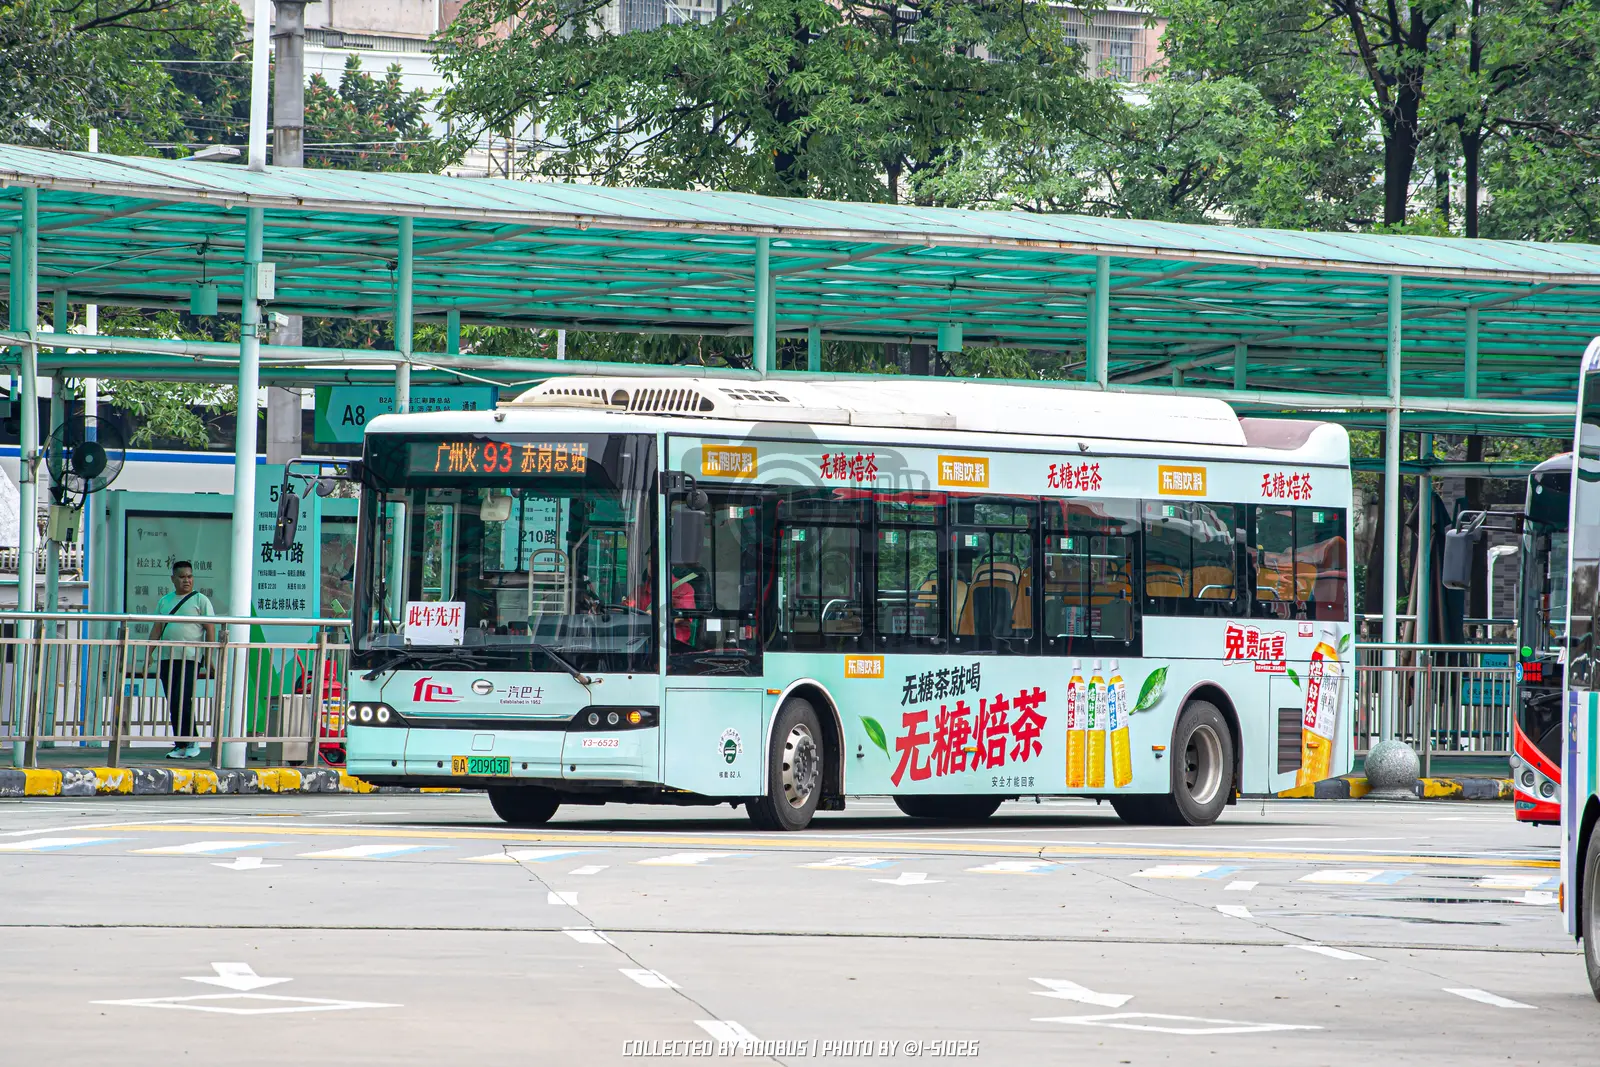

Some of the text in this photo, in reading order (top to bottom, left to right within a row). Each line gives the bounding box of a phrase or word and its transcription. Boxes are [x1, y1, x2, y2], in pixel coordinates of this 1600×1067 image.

[342, 405, 365, 426] A8
[483, 442, 513, 473] 93
[521, 443, 586, 473] 赤岗总站
[707, 450, 753, 473] 东鹏饮料
[819, 452, 878, 482] 无糖焙茶
[942, 461, 985, 482] 东鹏饮料
[1047, 462, 1103, 491] 无糖焙茶
[1162, 471, 1203, 491] 东鹏饮料
[1261, 472, 1313, 500] 无糖焙茶
[520, 529, 556, 544] 210路
[261, 541, 304, 563] 夜41路
[257, 598, 306, 611] 请在此排队候车
[408, 605, 462, 628] 此车先开
[1224, 625, 1285, 661] 免费乐享
[847, 659, 882, 675] 东鹏饮料
[496, 685, 545, 699] 一汽巴士
[901, 662, 981, 707] 无糖茶就喝
[1305, 660, 1324, 724] 焙好茶
[583, 739, 619, 748] Y3-6523
[890, 686, 1048, 788] 无糖焙茶
[470, 758, 510, 775] 20903D
[991, 776, 1035, 788] 安全才能回家
